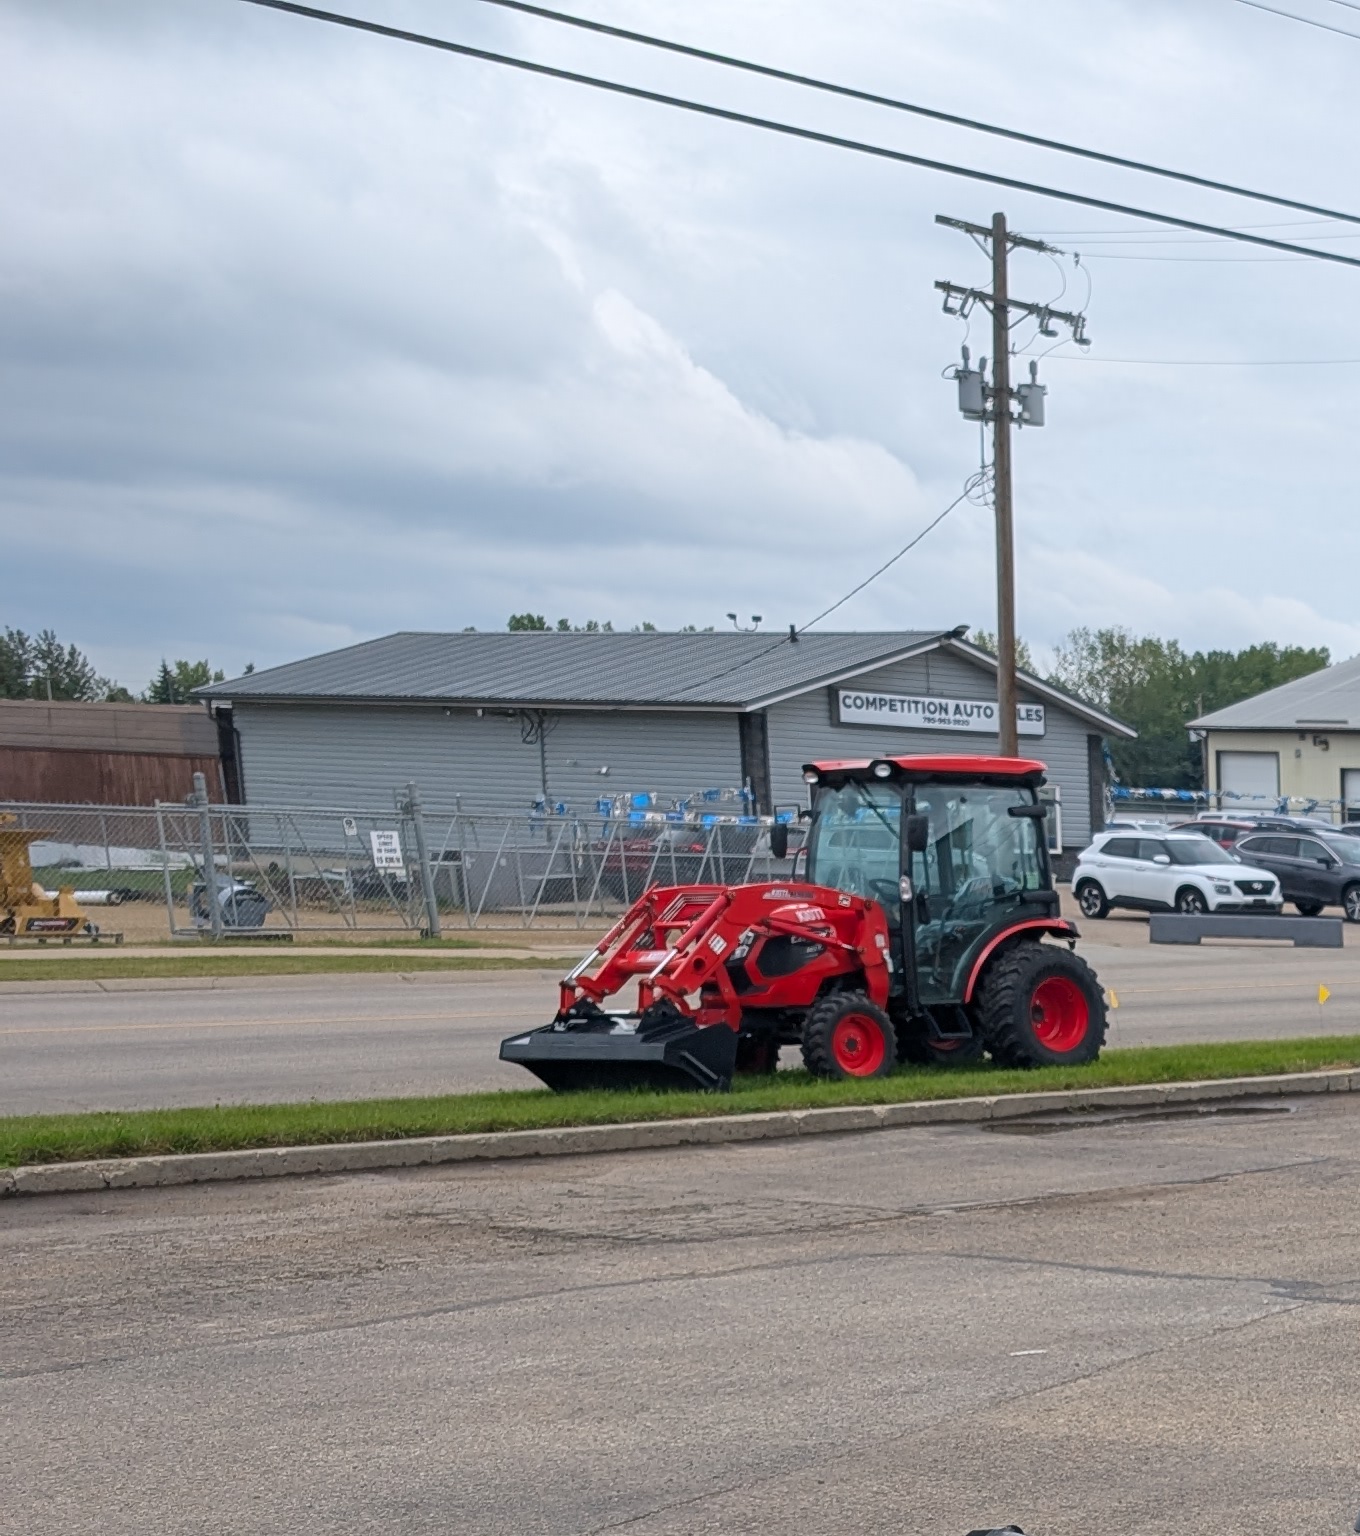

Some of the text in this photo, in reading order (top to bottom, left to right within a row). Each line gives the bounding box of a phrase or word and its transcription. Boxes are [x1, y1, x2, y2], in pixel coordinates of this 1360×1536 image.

[842, 694, 1043, 723] COMPETITION AUTO LES
